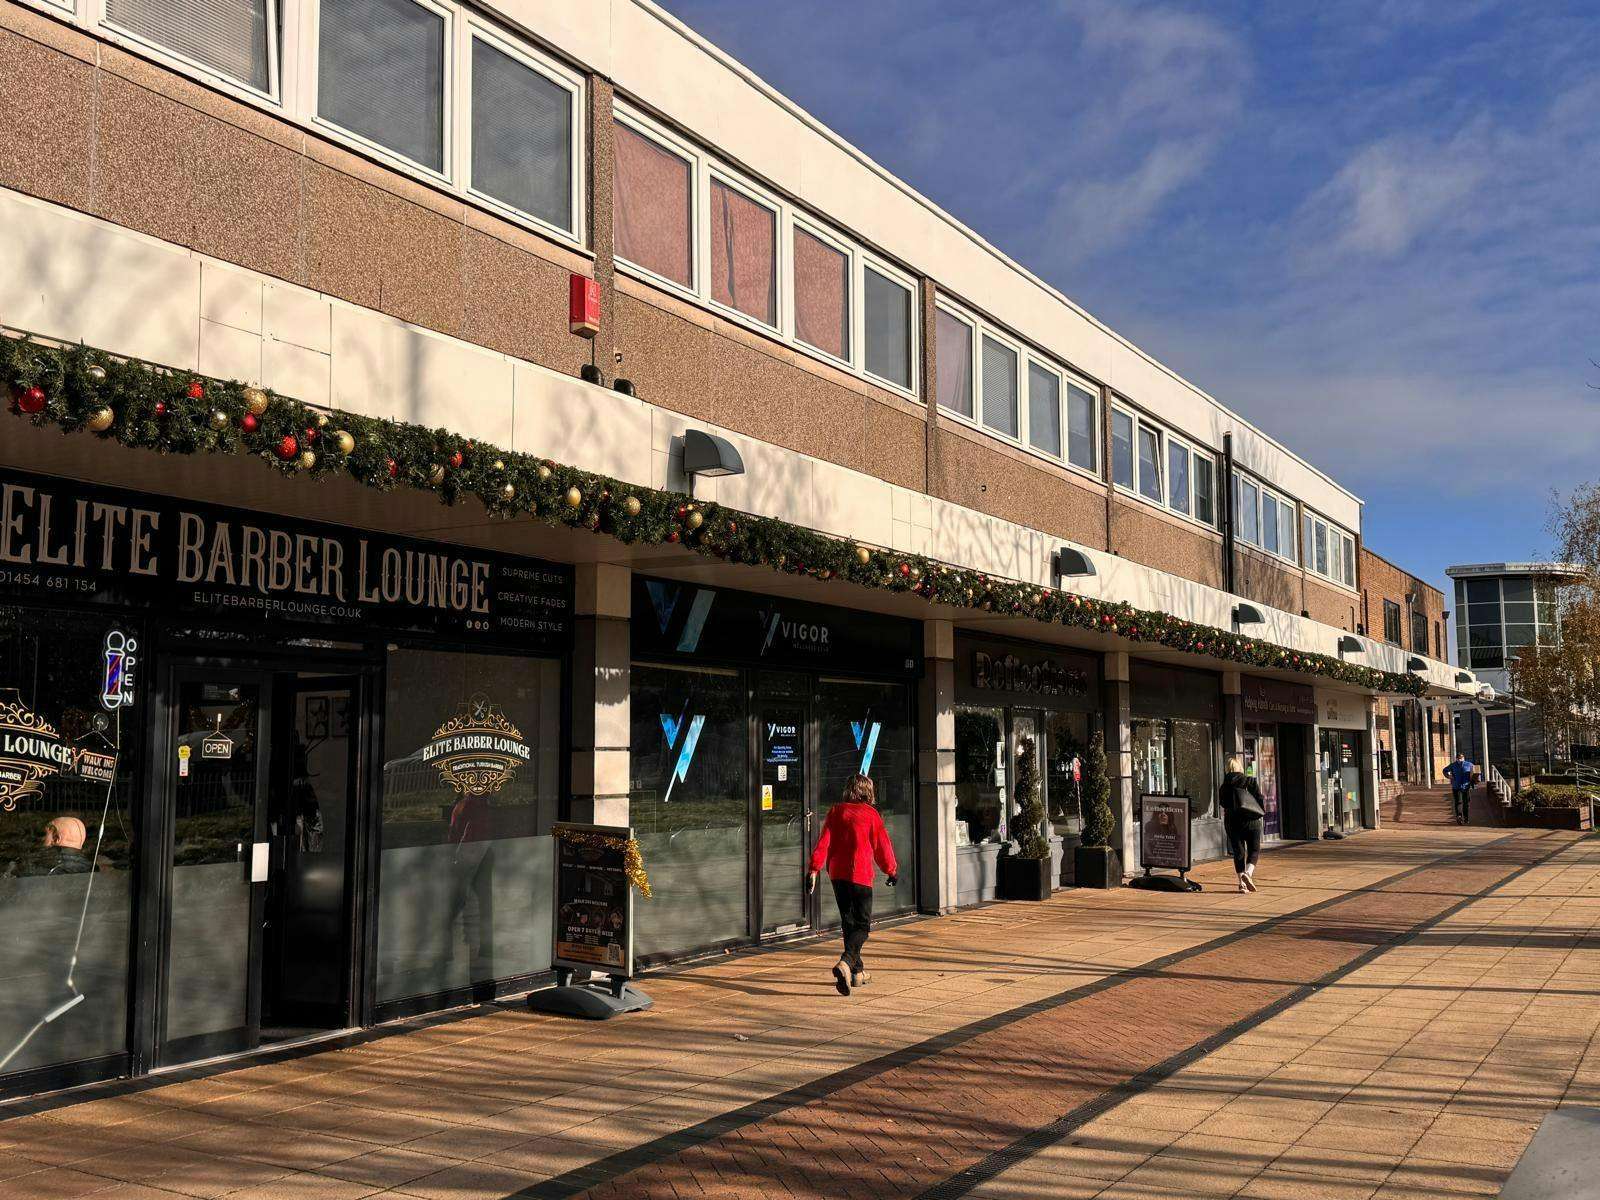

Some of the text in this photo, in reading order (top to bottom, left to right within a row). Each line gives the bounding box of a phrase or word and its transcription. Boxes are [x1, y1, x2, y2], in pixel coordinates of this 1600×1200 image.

[0, 483, 490, 614] ELITE BARBER LOUNGE
[46, 576, 68, 590] 681
[74, 578, 97, 592] 154
[502, 567, 564, 584] SUPREME CUTS
[194, 591, 362, 619] ELITEBARBERLOUNGE.CO.UK
[497, 591, 566, 609] CREATIVE FADES
[500, 616, 563, 632] MODERN STYLE
[781, 621, 829, 643] VIGOR
[124, 638, 138, 704] OPEN
[776, 725, 796, 734] VIGOR
[4, 734, 72, 765] LOUNGE
[205, 743, 229, 753] OPEN
[423, 736, 531, 761] ELITE BARBER LOUNGE
[84, 754, 114, 768] WALK INS
[82, 764, 113, 779] WELCOME
